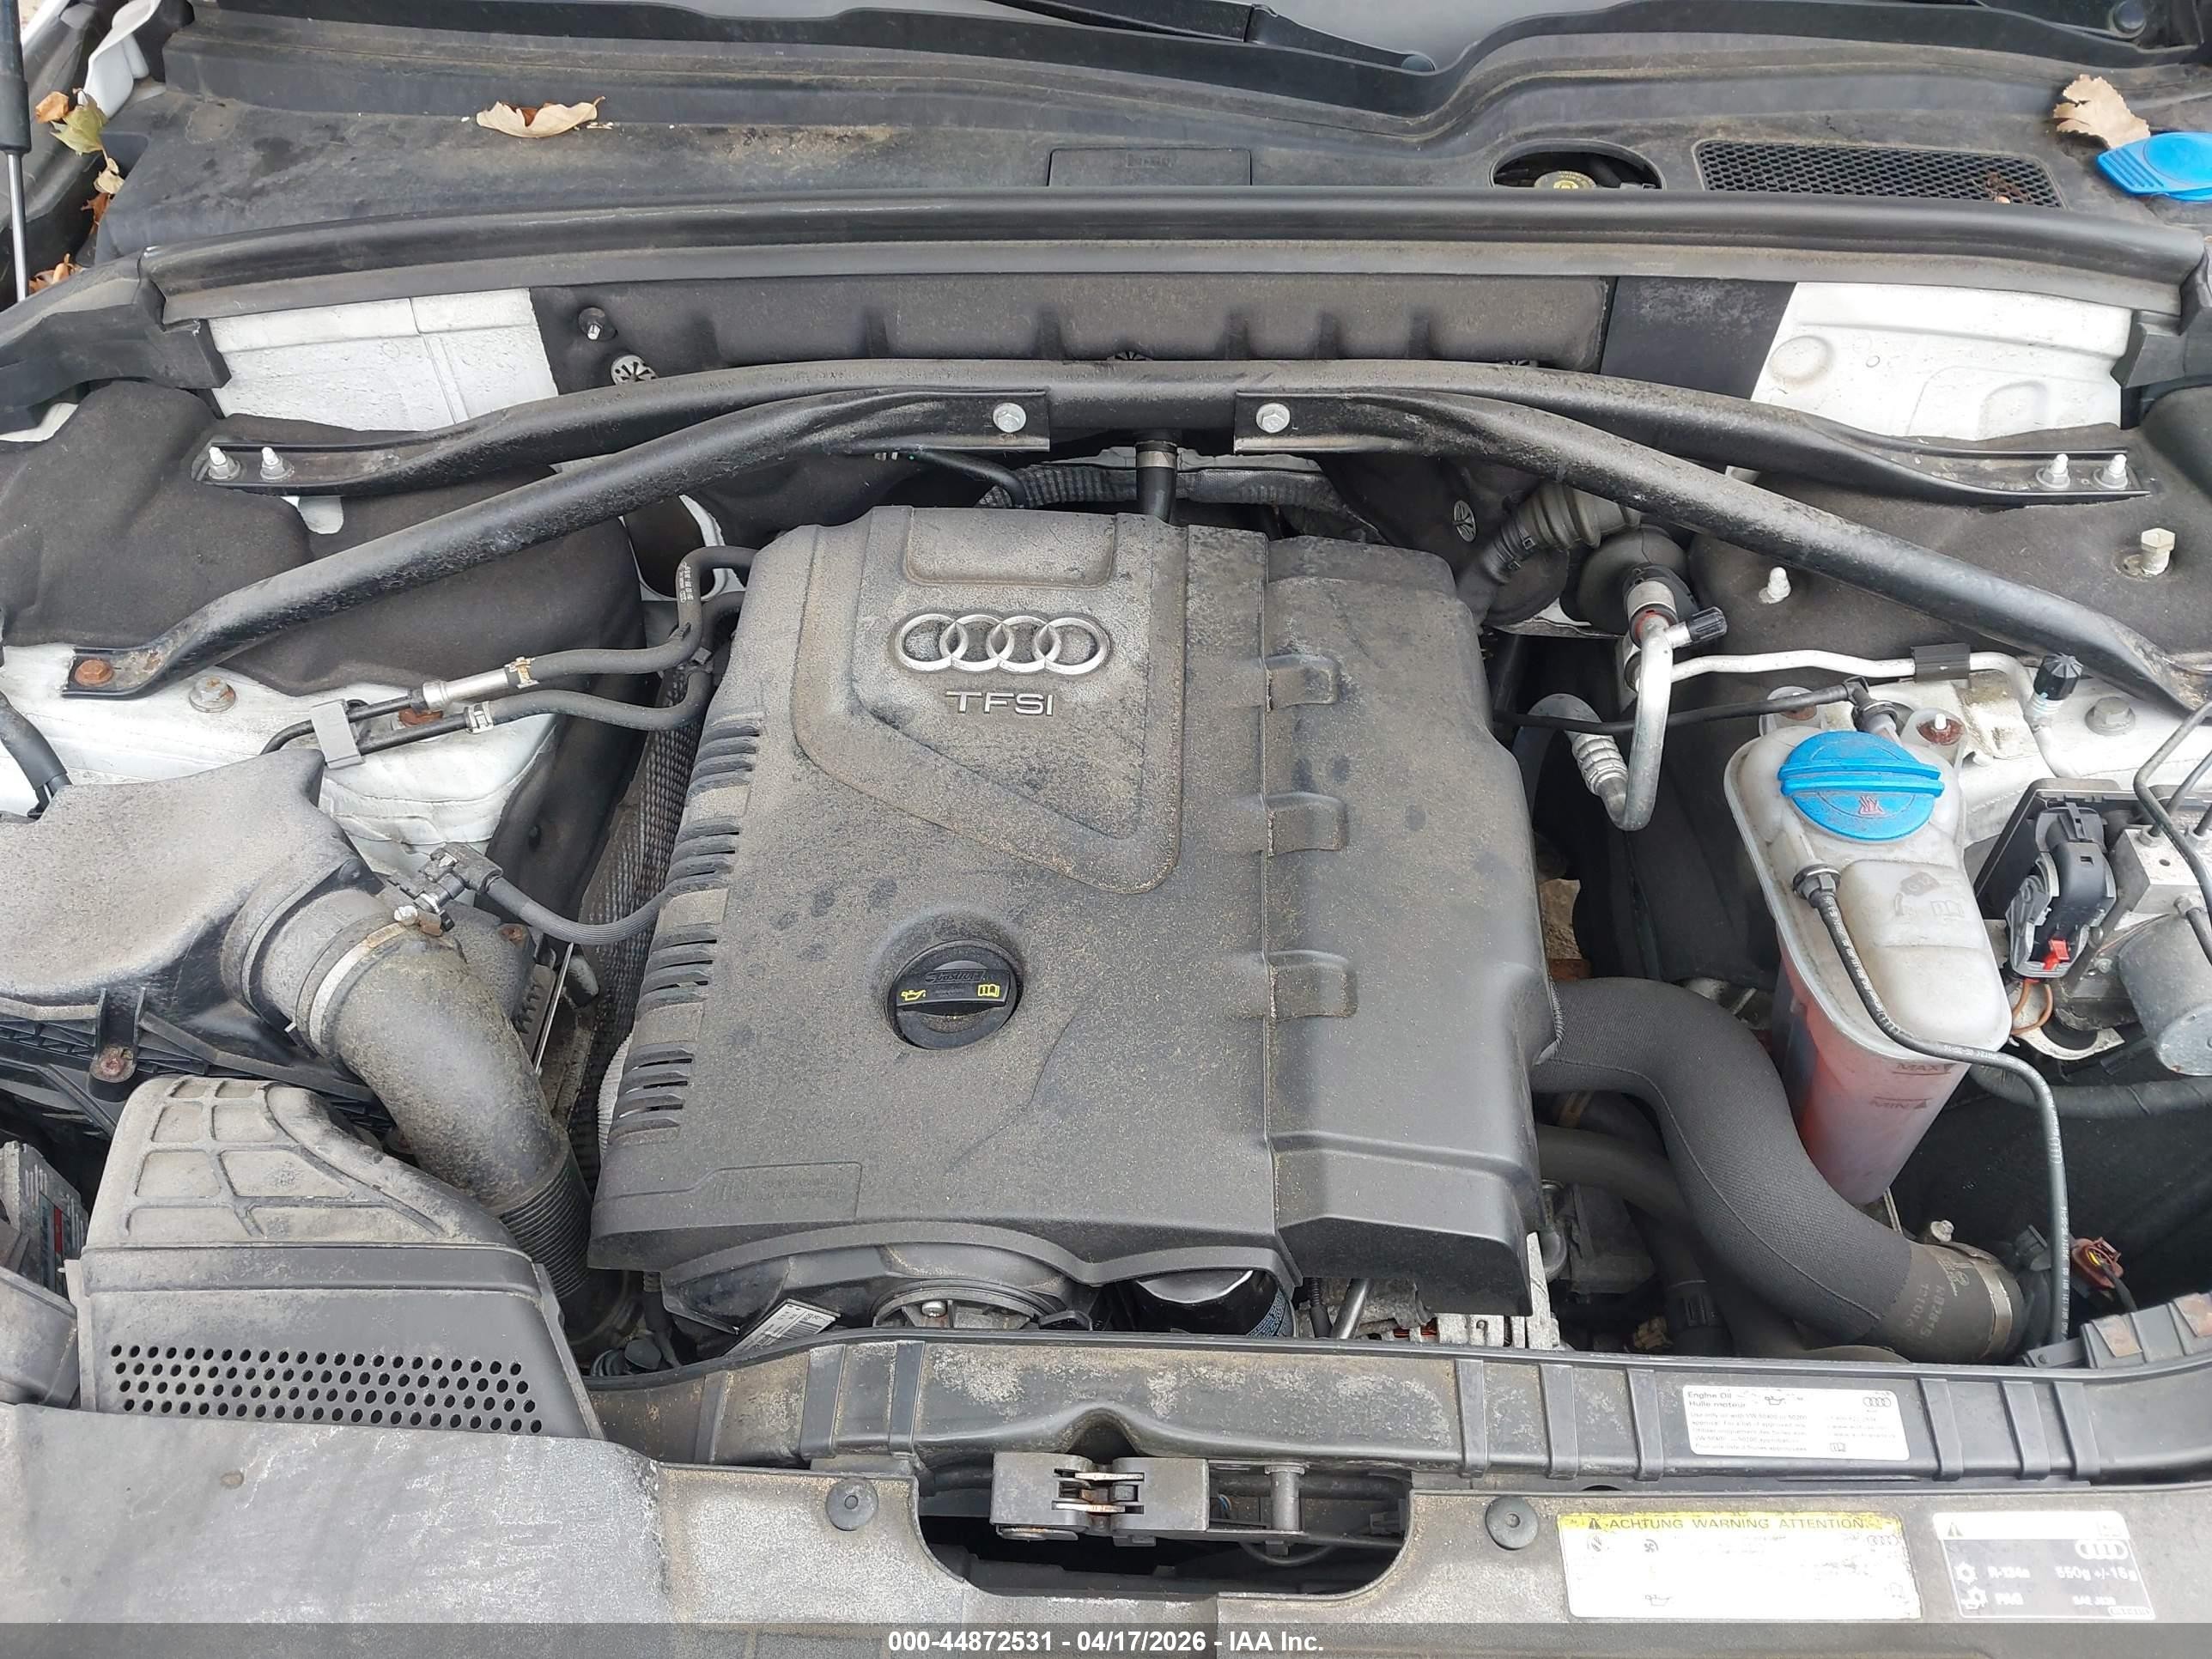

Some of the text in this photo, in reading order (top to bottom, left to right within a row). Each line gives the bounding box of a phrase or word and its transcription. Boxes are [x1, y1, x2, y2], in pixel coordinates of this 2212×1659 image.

[945, 690, 1054, 716] TFSI
[1896, 1062, 1938, 1072] MAX
[1687, 1391, 1717, 1400] Engine
[1609, 1517, 1864, 1530] ACHTUNG WARNING ATTENTION
